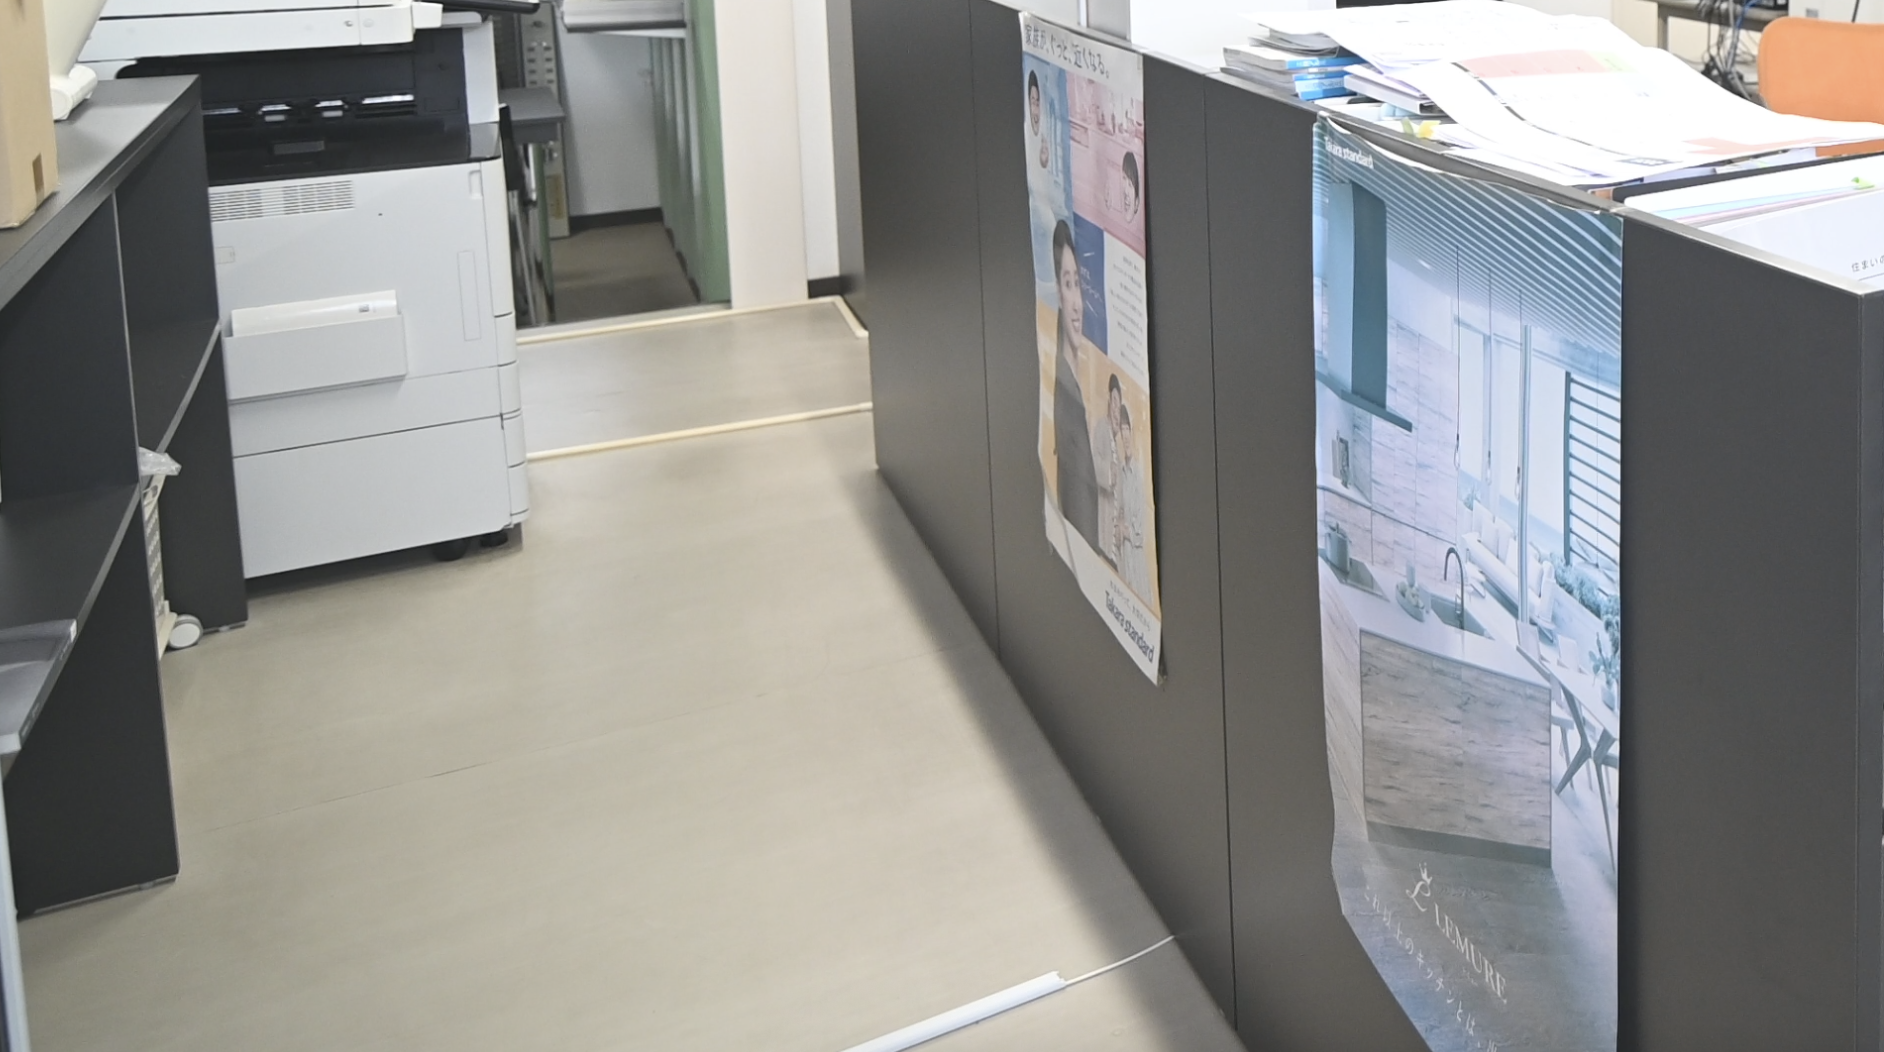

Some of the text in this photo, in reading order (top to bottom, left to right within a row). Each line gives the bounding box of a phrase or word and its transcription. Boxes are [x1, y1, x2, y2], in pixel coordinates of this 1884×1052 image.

[1342, 147, 1375, 170] standard
[1105, 589, 1125, 628] Takara
[1123, 619, 1155, 664] standard
[1434, 901, 1508, 1005] LEMURE
